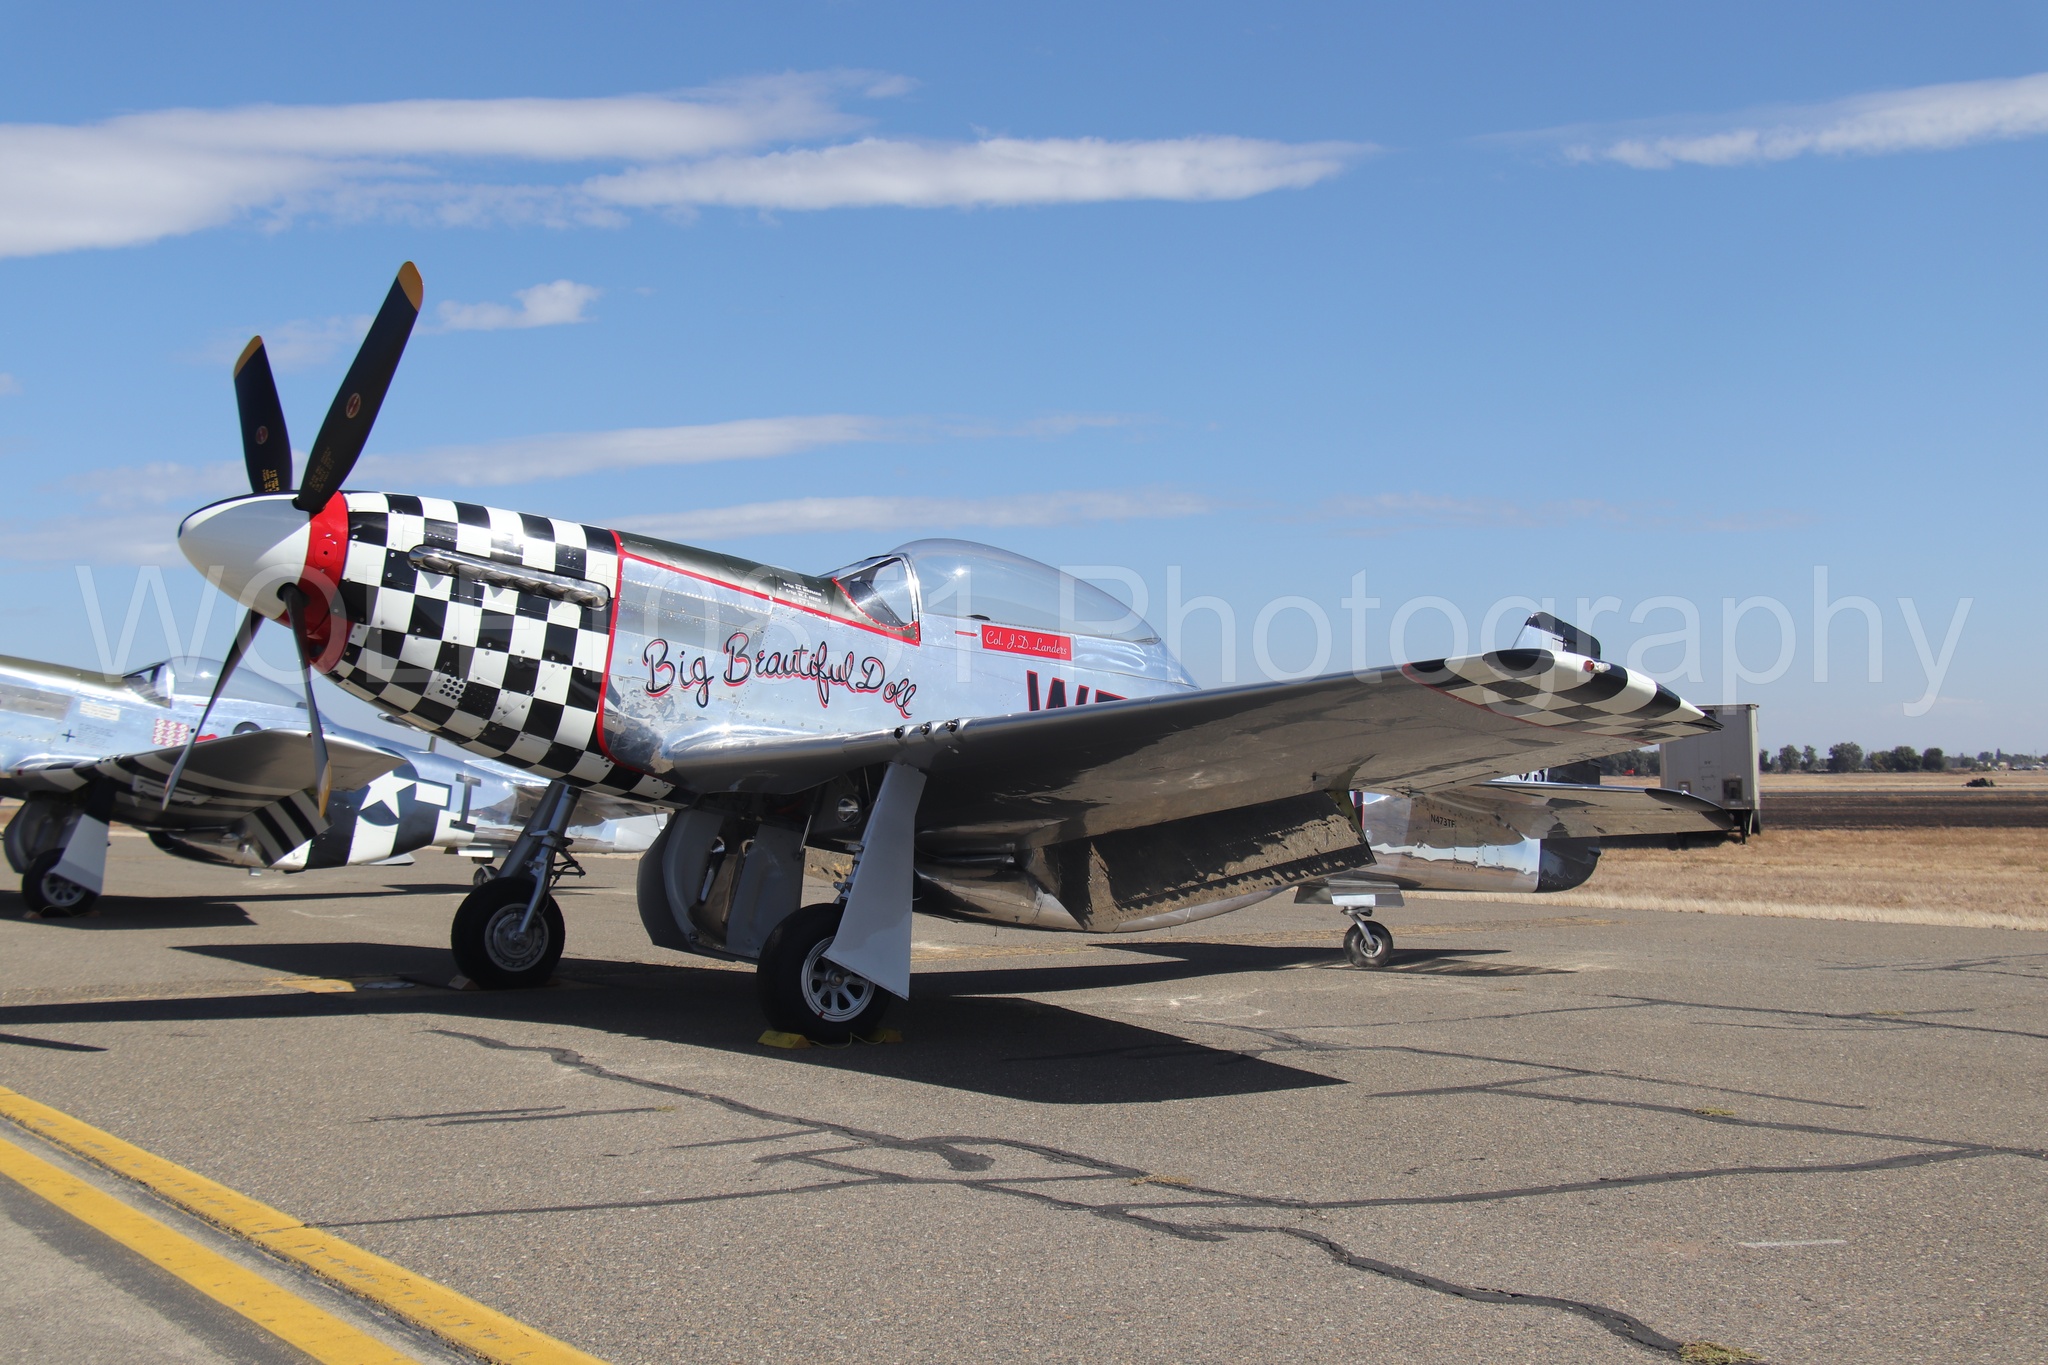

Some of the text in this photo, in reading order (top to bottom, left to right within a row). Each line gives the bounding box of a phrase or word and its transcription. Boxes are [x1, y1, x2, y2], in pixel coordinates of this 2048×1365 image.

[986, 630, 1004, 646] Col.
[642, 631, 917, 719] Big Beautiful Doll
